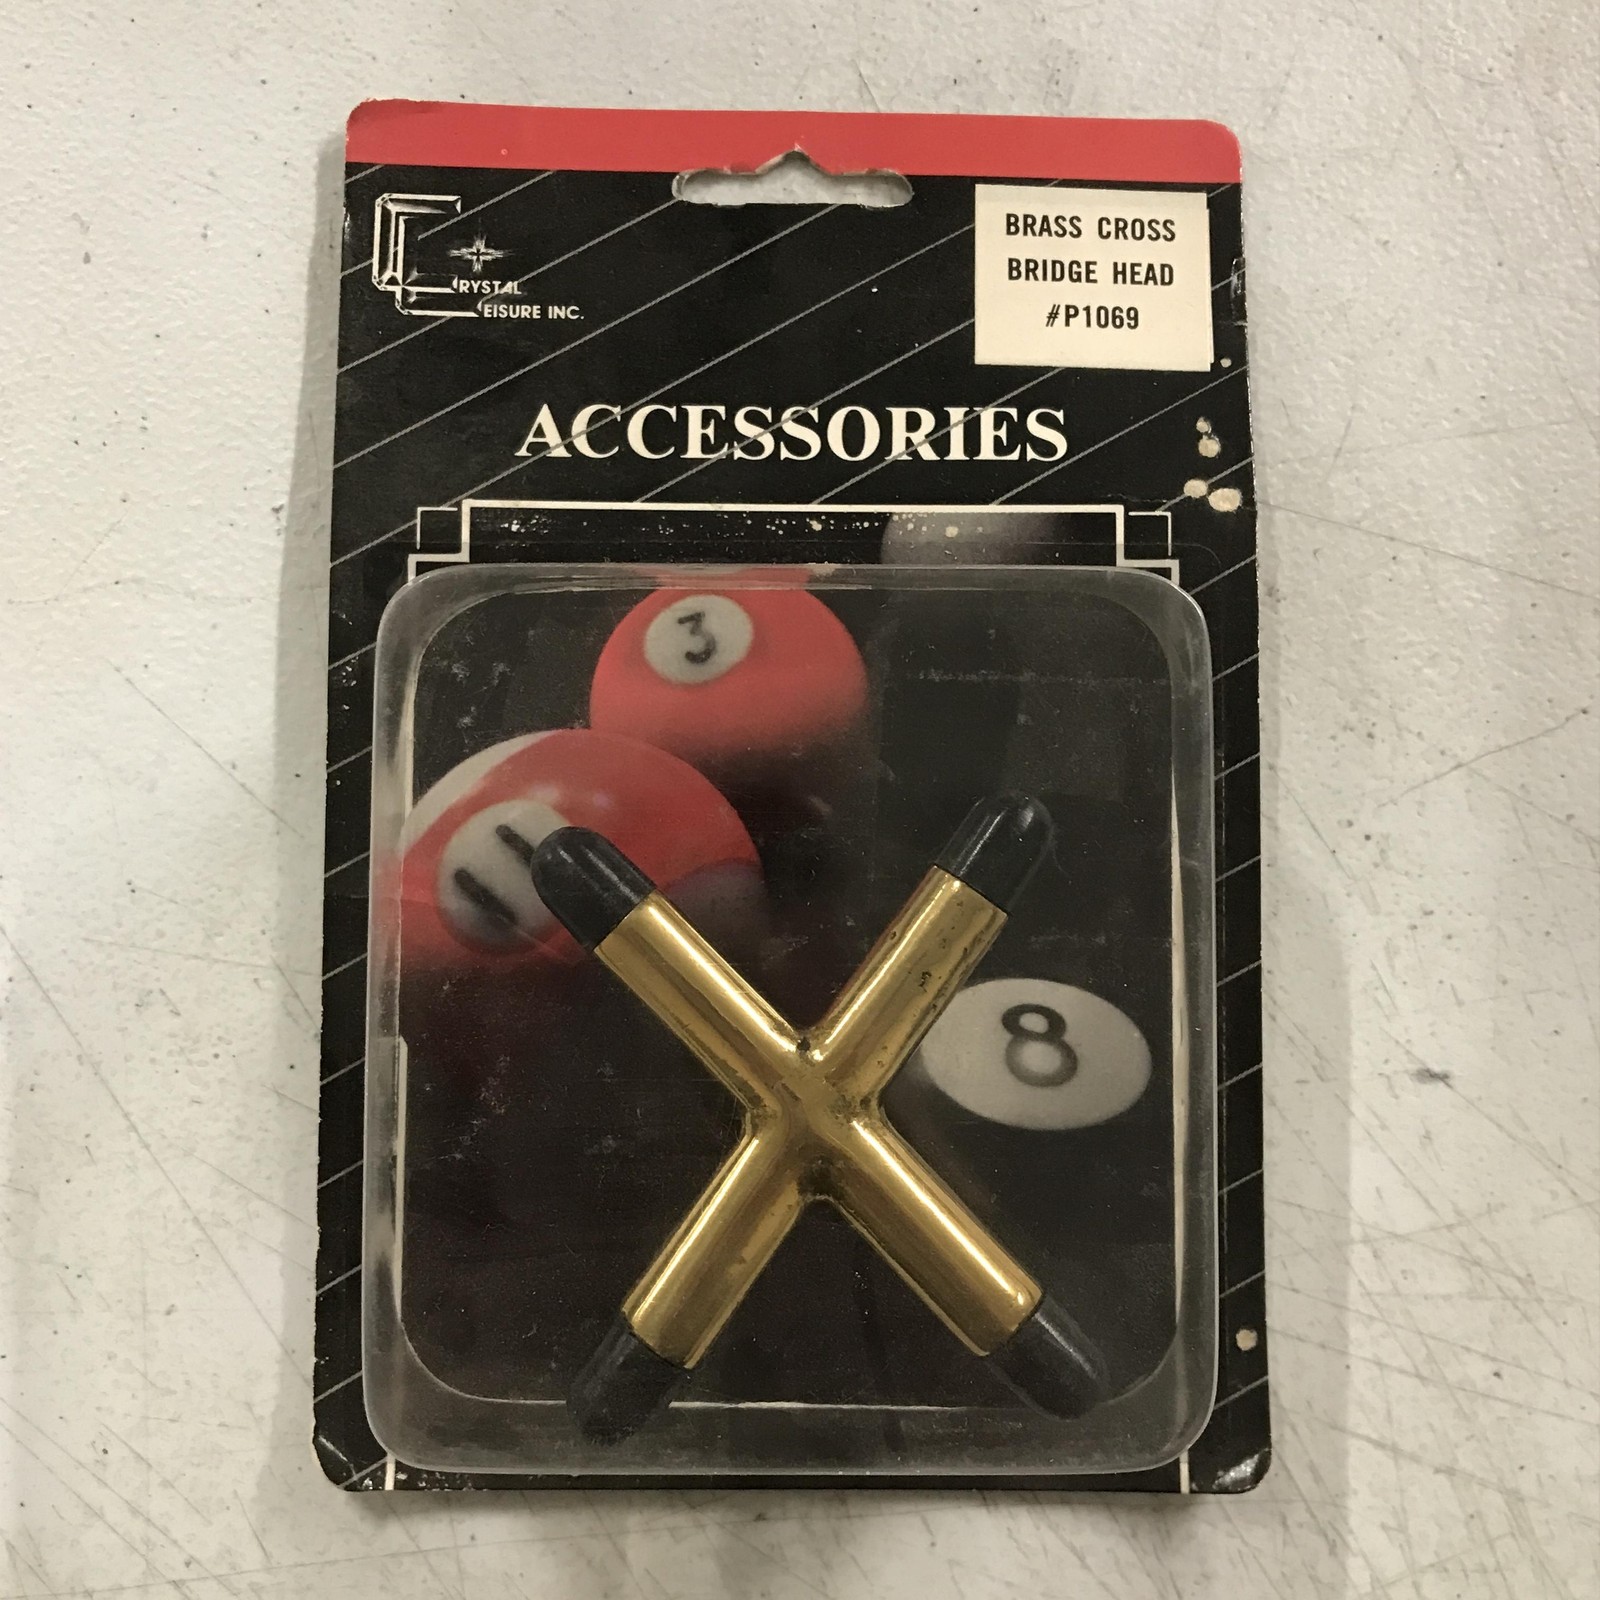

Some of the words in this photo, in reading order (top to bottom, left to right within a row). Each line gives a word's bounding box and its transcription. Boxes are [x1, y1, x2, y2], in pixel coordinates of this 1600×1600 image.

[1005, 213, 1082, 239] BRASS
[1097, 216, 1176, 242] CROSS
[1007, 257, 1098, 284] BRIDGE
[1112, 261, 1174, 287] HEAD
[548, 304, 585, 320] INC.
[1045, 303, 1140, 330] #P1069
[514, 402, 1069, 463] ACCESSORIES
[676, 610, 717, 665] 3
[1001, 1002, 1079, 1088] 8
